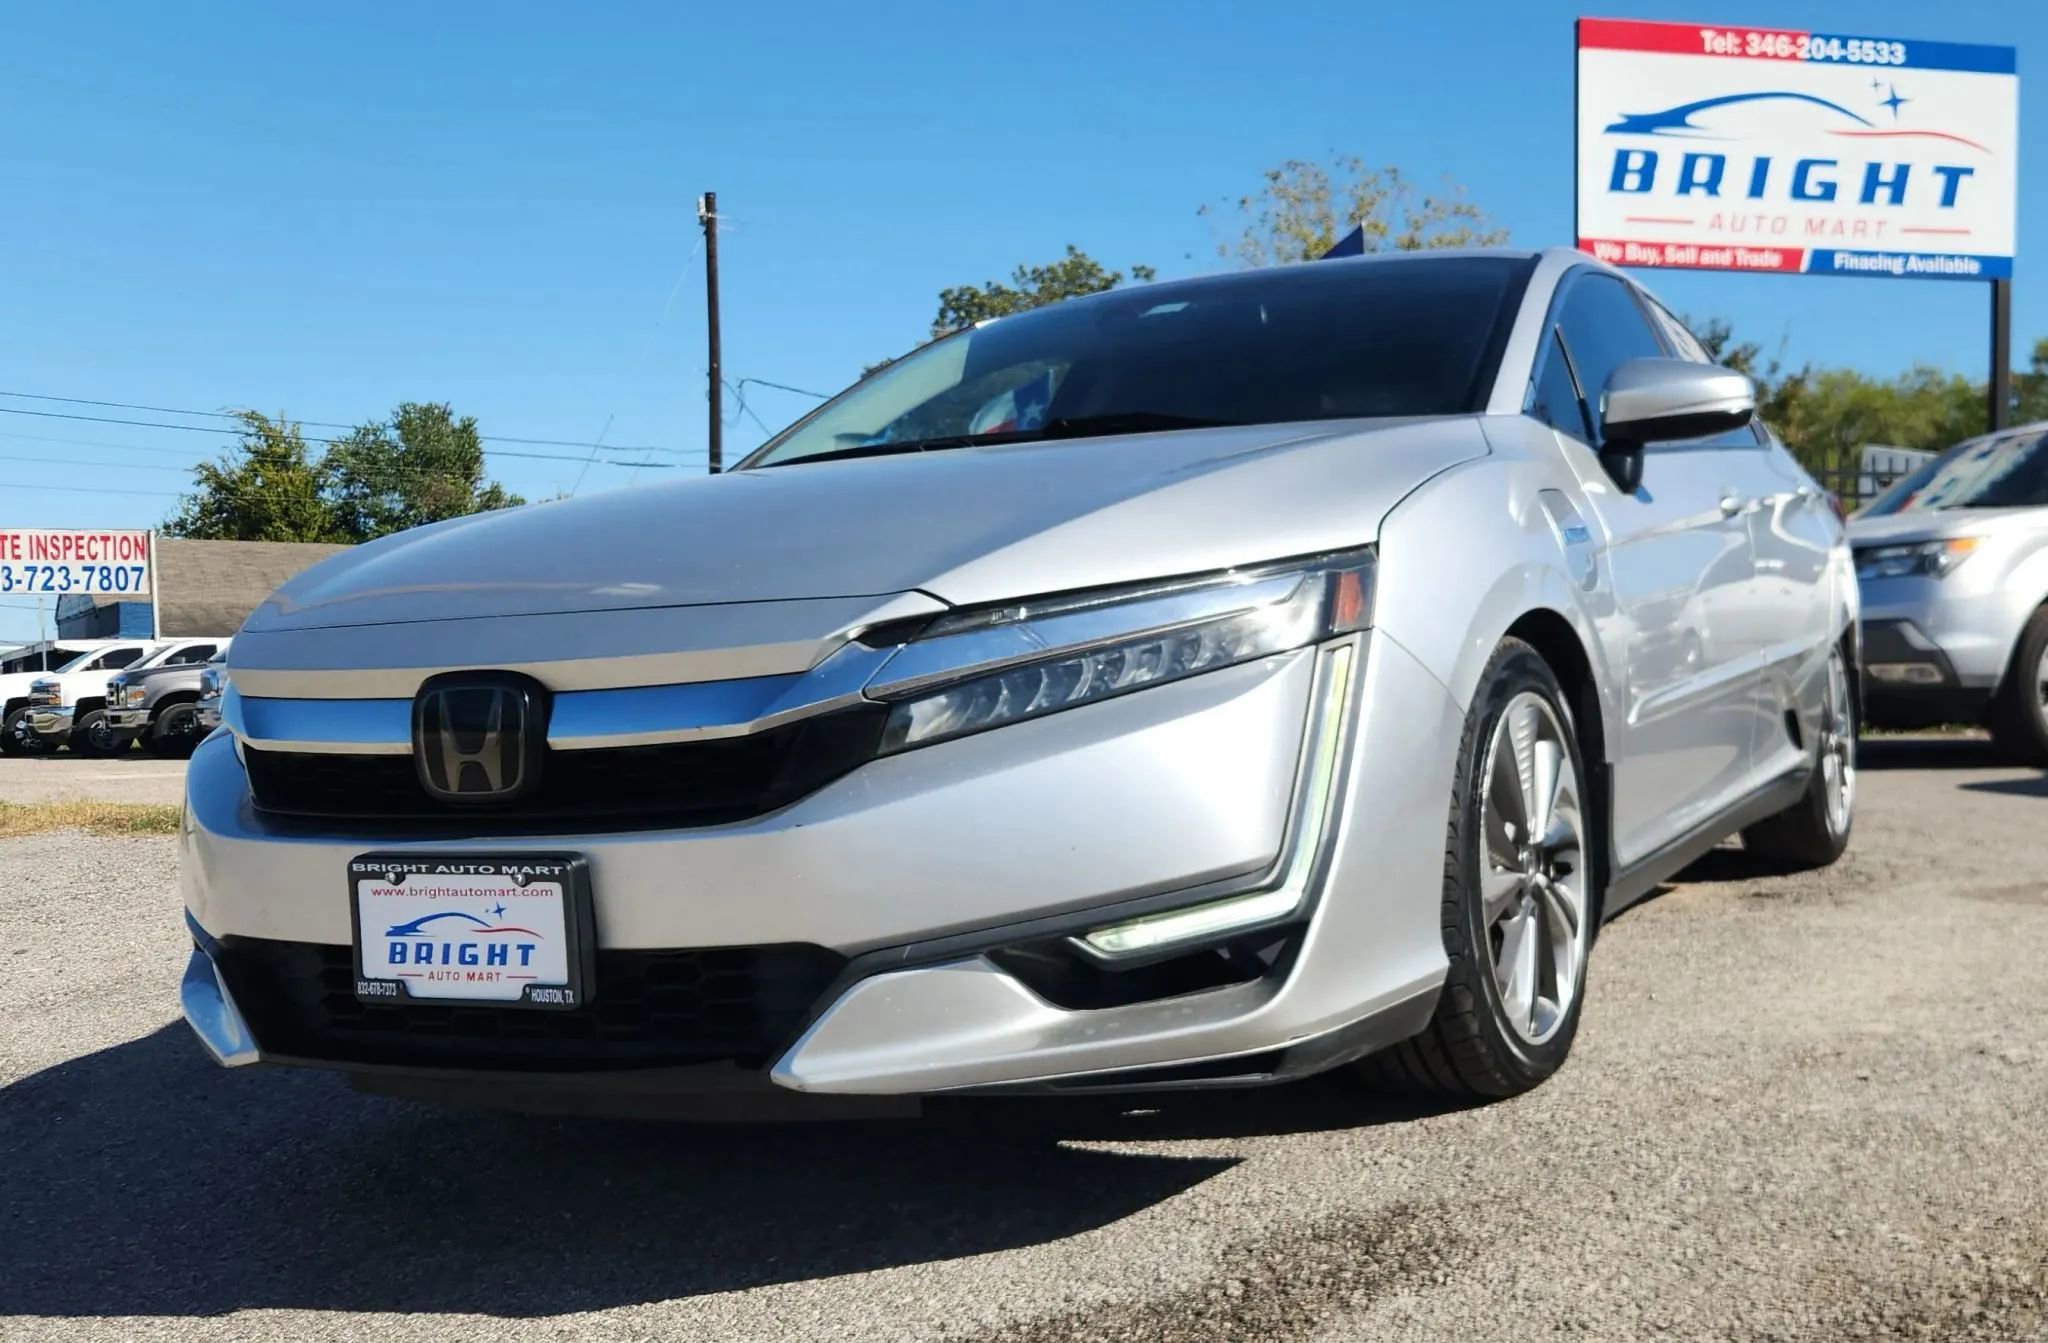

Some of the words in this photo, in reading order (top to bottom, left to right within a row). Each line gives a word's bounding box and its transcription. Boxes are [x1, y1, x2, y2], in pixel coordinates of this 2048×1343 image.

[1701, 29, 1742, 55] Tel:
[1745, 33, 1906, 65] 346-204-5533
[1608, 148, 1975, 209] BRIGHT
[1707, 213, 1788, 236] AUTO
[1804, 215, 1890, 240] MART
[1593, 241, 1623, 261] We
[1625, 243, 1663, 265] Buy,
[1664, 245, 1699, 265] Sell
[1700, 248, 1734, 266] and
[1736, 248, 1783, 268] Trade
[1834, 251, 1905, 275] Finacing
[1905, 255, 1981, 275] Available
[29, 534, 146, 561] INSPECTION
[1, 565, 145, 592] 3-723-7807
[352, 863, 430, 873] BRIGHT
[435, 865, 495, 874] AUTO
[501, 865, 564, 875] MART
[371, 886, 554, 899] www.brightautomart.com
[388, 942, 536, 967] BRIGHT
[428, 971, 460, 981] AUTO
[466, 972, 501, 982] MART
[531, 988, 565, 1005] HOUSTON,
[565, 989, 574, 1004] TX
